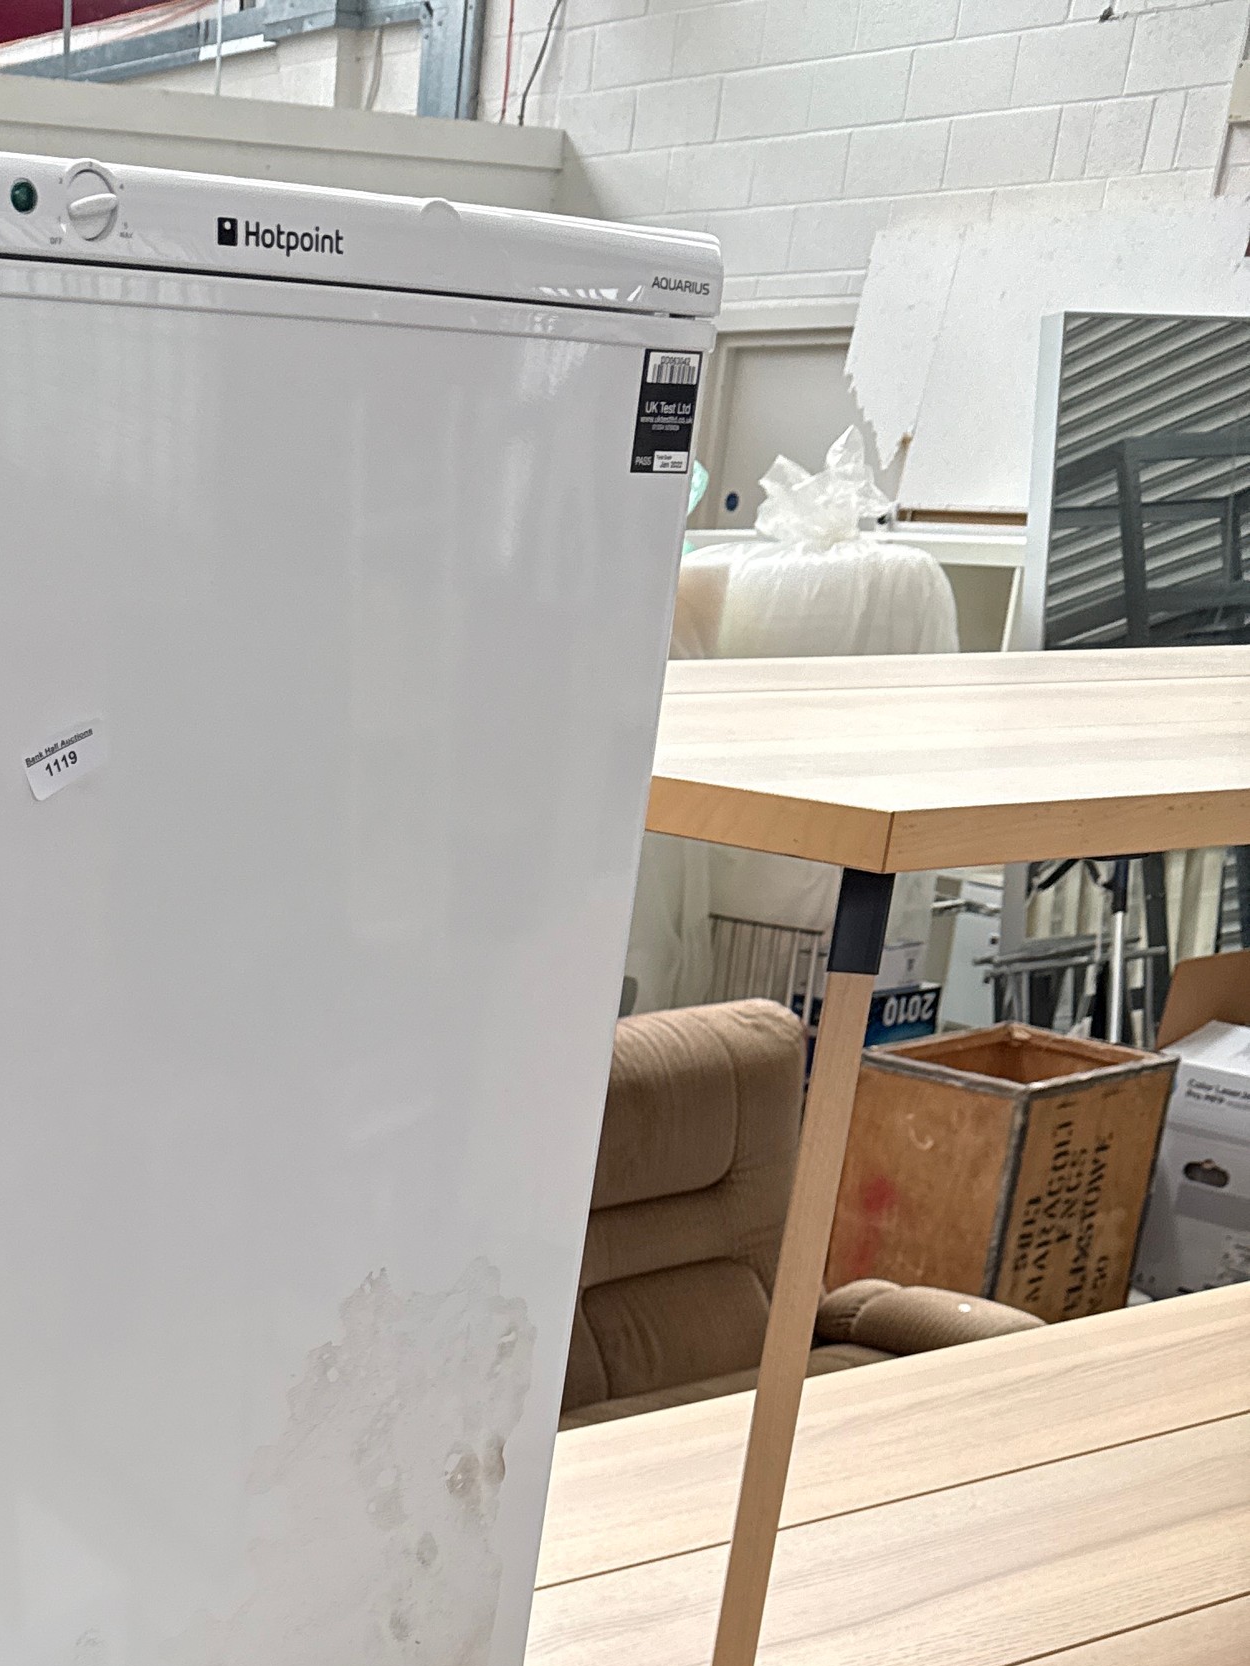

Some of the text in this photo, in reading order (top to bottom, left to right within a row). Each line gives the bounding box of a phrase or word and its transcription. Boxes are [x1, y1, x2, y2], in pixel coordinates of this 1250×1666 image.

[244, 220, 344, 257] Hotpoint
[651, 276, 710, 296] AQUARIUS
[645, 401, 692, 415] UK Test Ltd
[635, 456, 652, 466] PASS
[25, 728, 93, 768] Bank Hall Auctions
[45, 750, 78, 776] 1119
[882, 993, 936, 1028] 2010
[1187, 1078, 1213, 1091] Color
